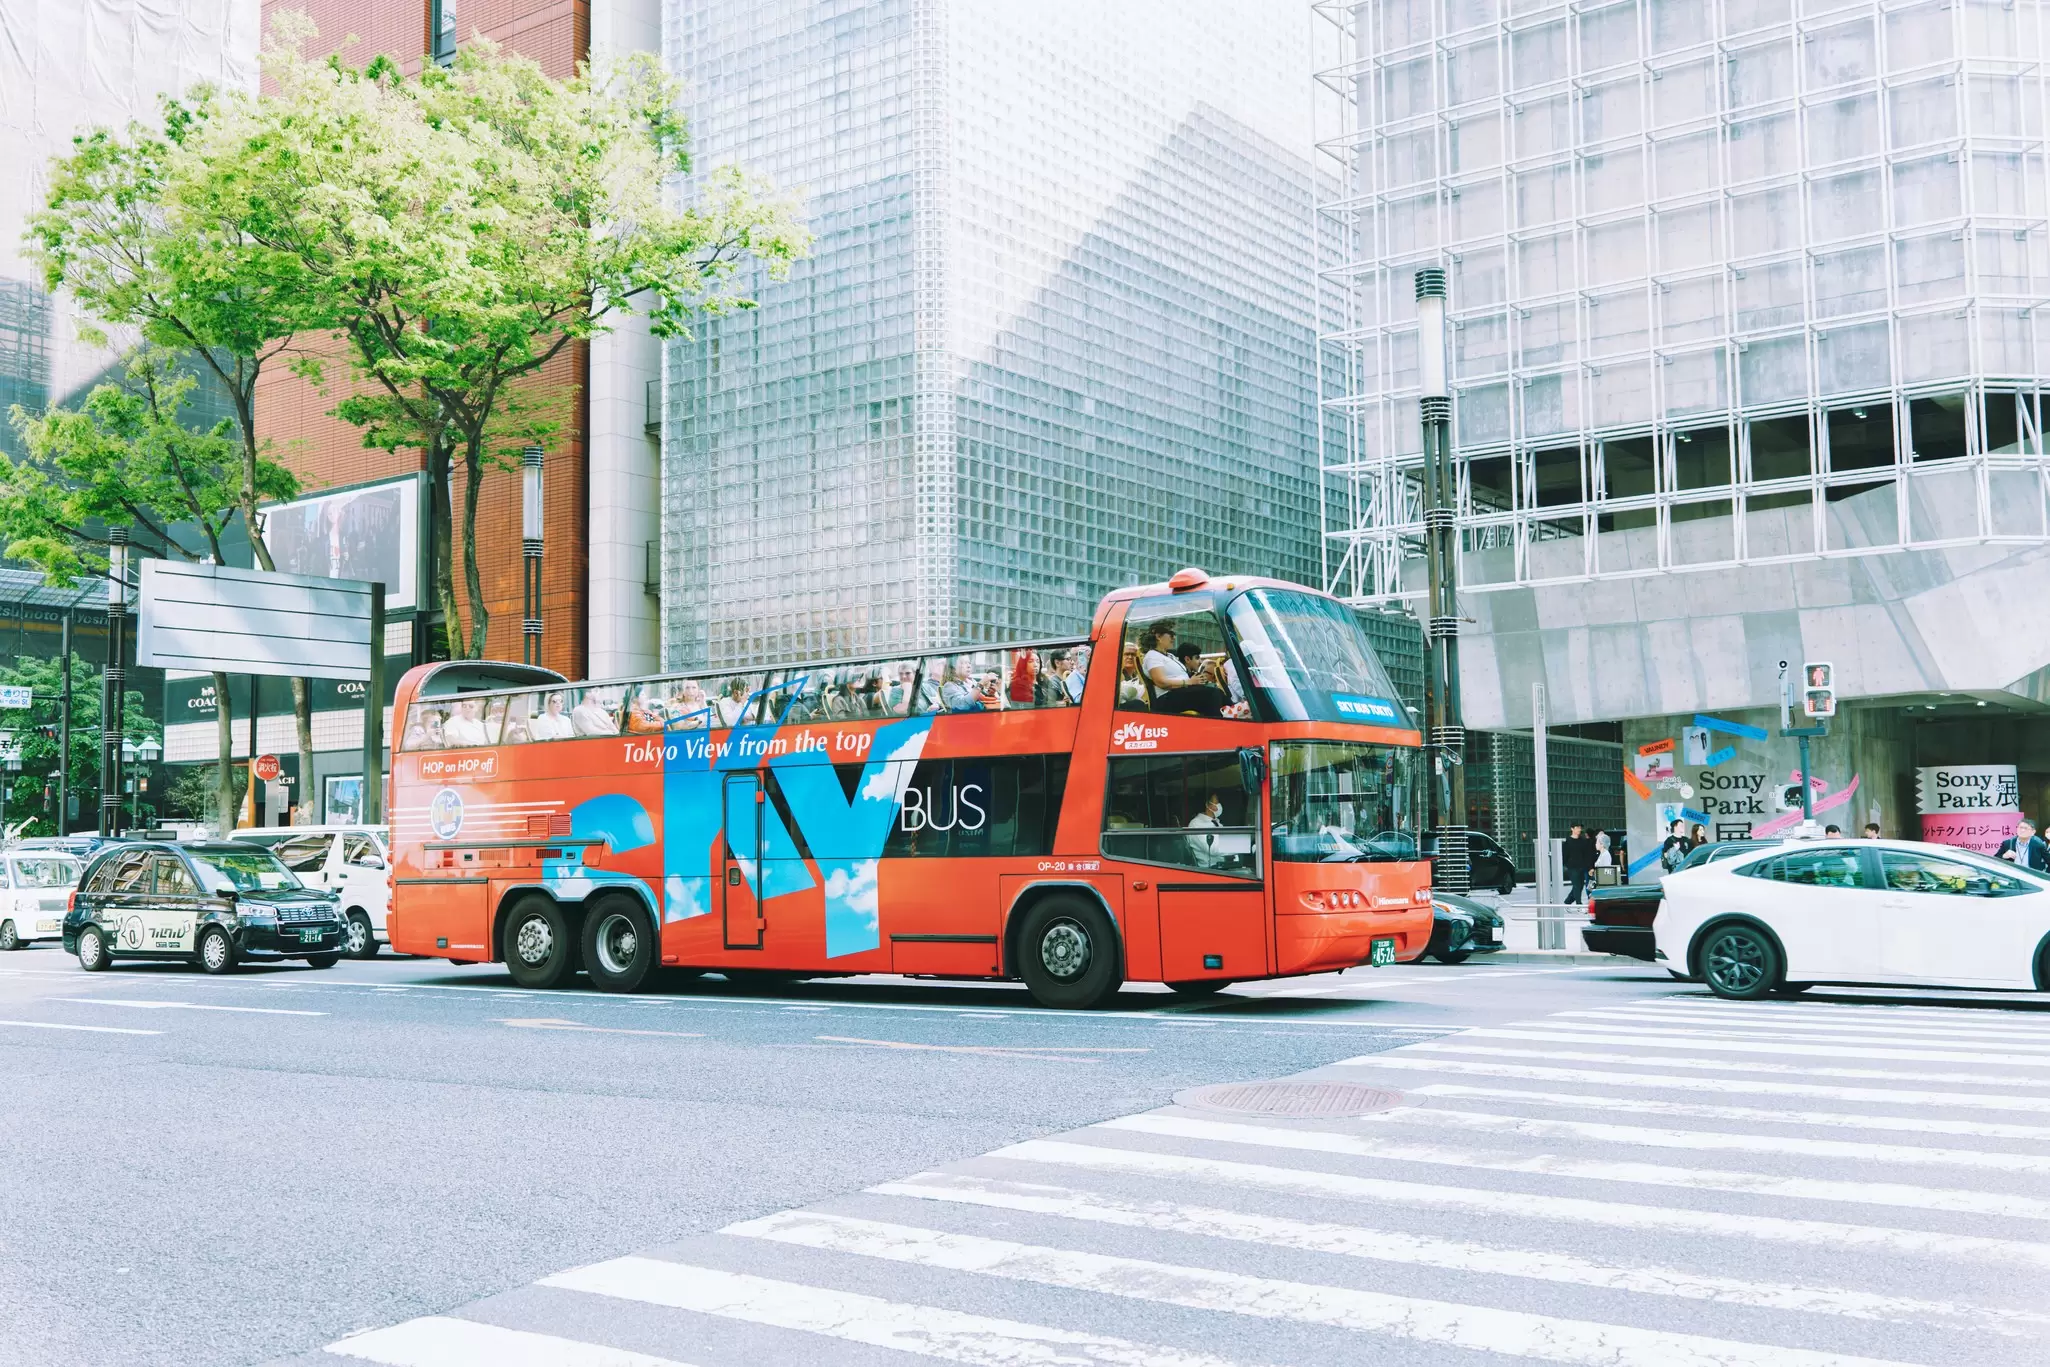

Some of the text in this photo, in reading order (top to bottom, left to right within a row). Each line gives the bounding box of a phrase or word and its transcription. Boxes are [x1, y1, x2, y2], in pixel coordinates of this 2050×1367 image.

[337, 682, 366, 693] COA
[188, 697, 218, 708] COAC
[1336, 700, 1394, 718] SKY BUS TOKYO
[1114, 721, 1168, 745] SKY BUS
[624, 729, 871, 767] Tokyo View from the top
[1644, 742, 1669, 754] VAUNDY
[258, 762, 277, 772] 消火栓
[423, 757, 494, 774] HOP on HOP off
[1699, 771, 1765, 794] Sony
[1936, 772, 1992, 790] Sony
[1996, 774, 2018, 806] 展
[902, 784, 986, 831] BUS
[1700, 796, 1765, 815] Park
[1937, 792, 1992, 808] Park
[1038, 862, 1065, 871] OP-20
